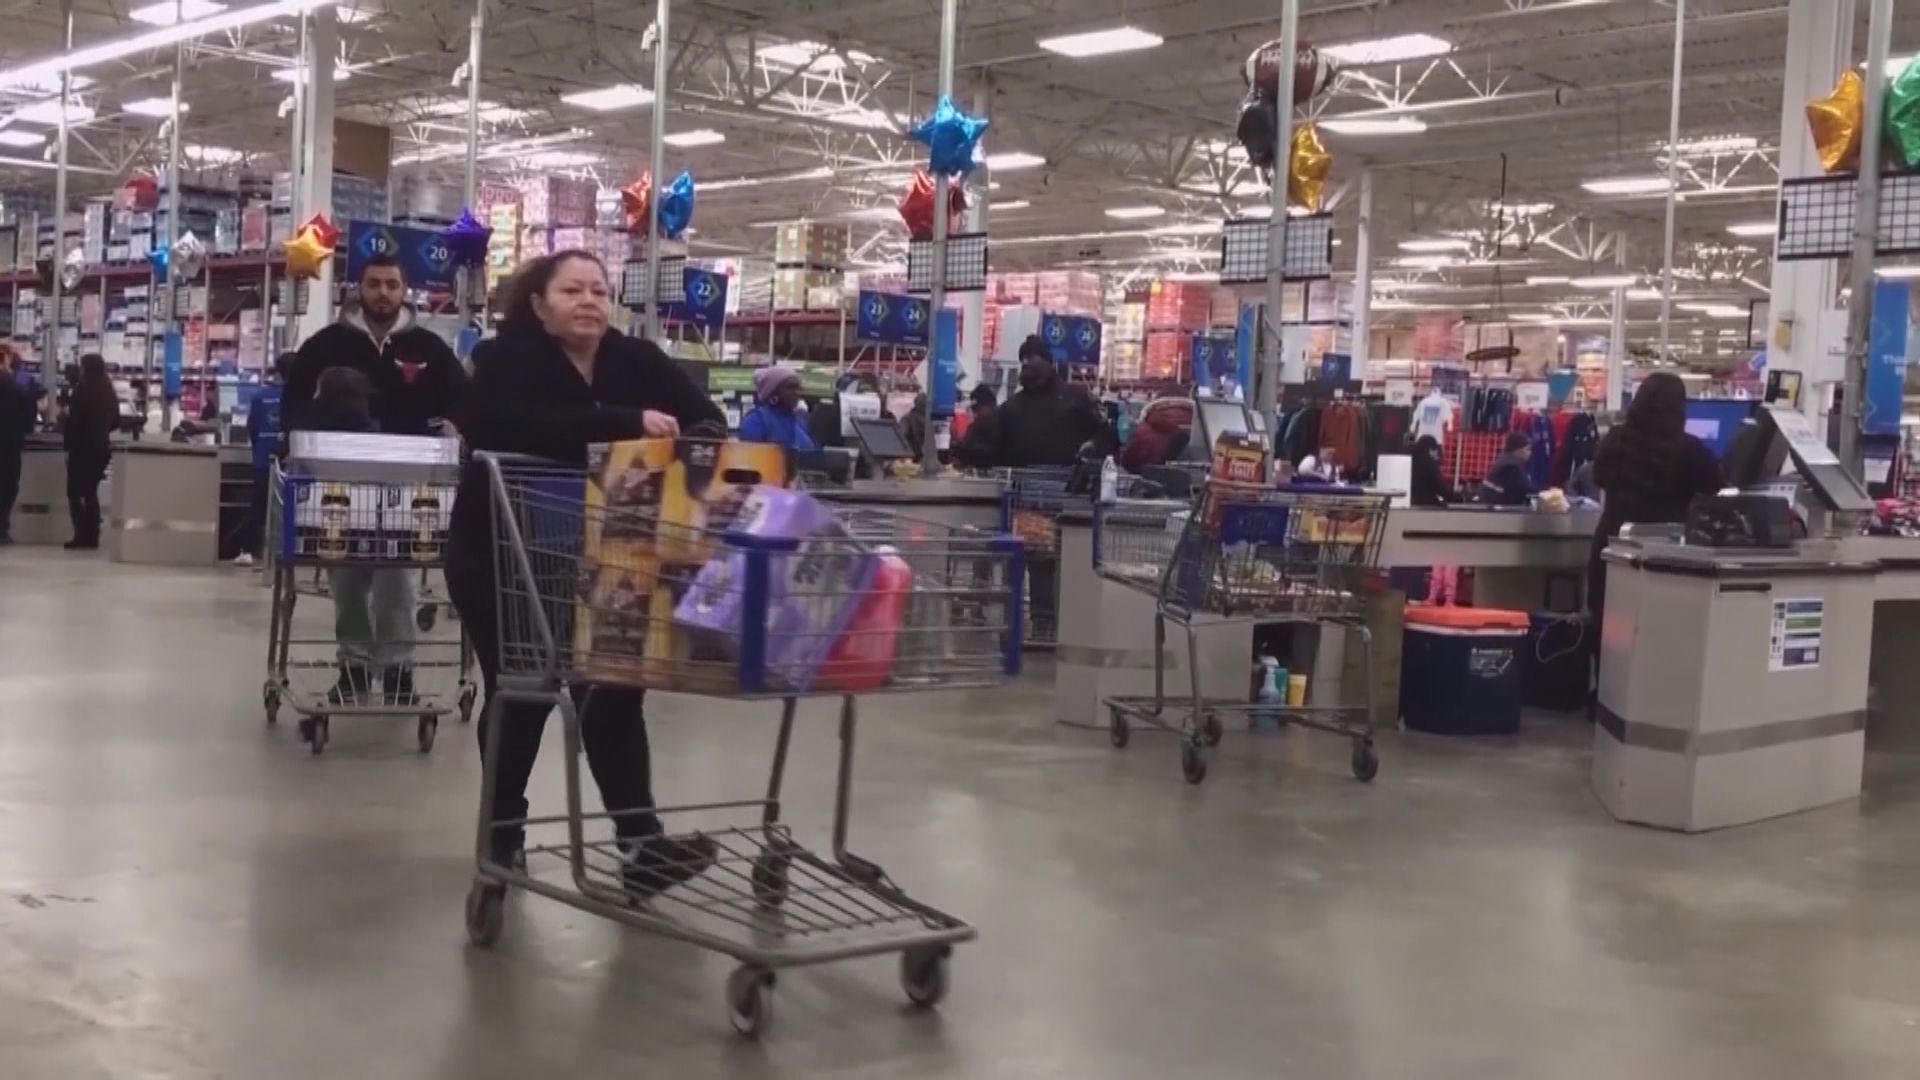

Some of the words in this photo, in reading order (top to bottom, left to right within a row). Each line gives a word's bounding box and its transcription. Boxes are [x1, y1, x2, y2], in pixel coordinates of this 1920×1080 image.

[370, 238, 387, 252] 19
[429, 246, 448, 260] 20
[697, 282, 711, 295] 22
[908, 308, 920, 320] 24
